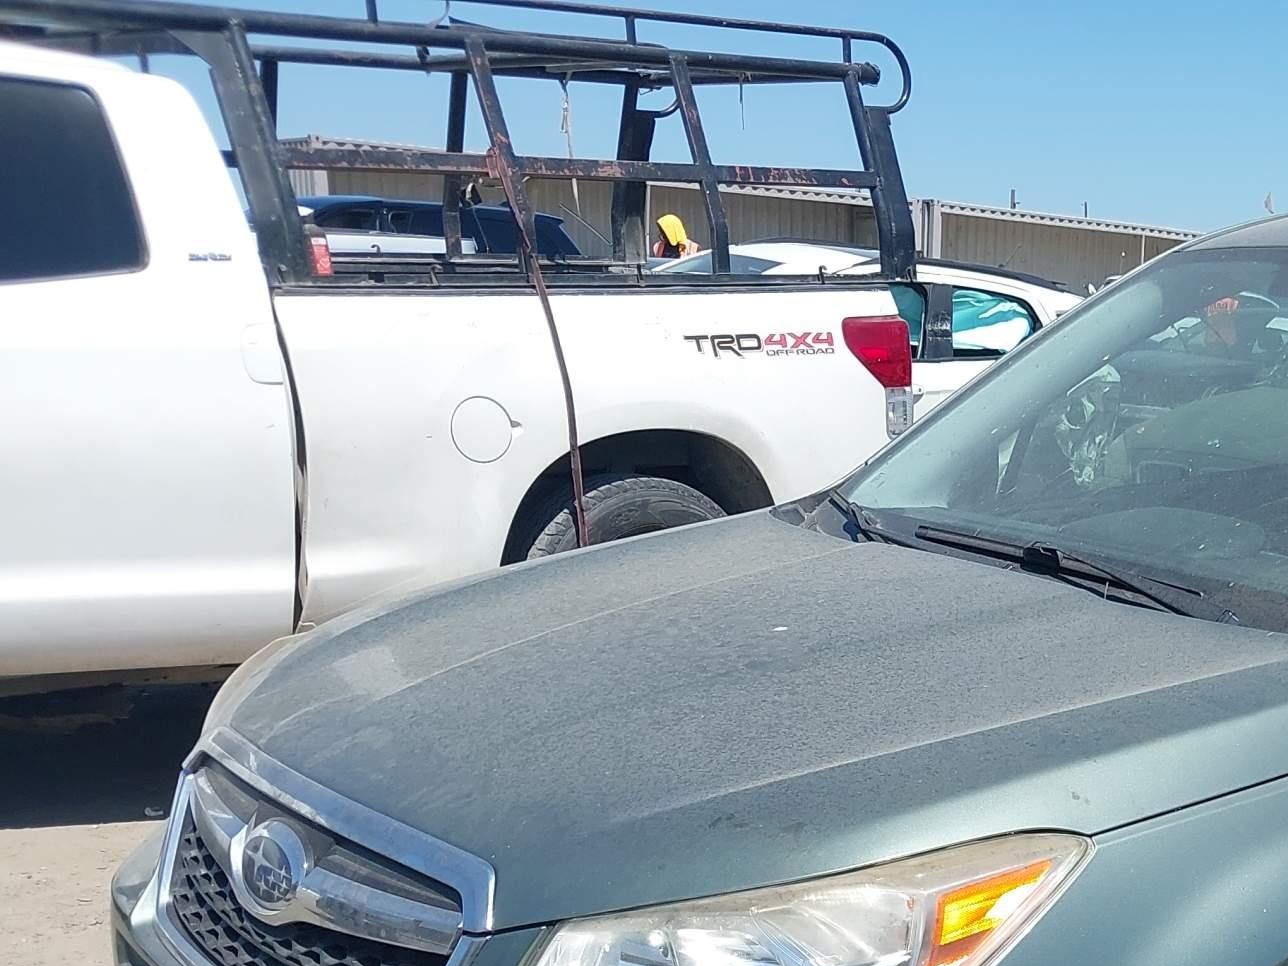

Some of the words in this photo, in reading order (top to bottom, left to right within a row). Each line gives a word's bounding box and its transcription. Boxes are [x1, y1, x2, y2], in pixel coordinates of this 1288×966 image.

[683, 333, 763, 359] TRD
[766, 349, 795, 357] OFF
[796, 347, 835, 355] ROAD
